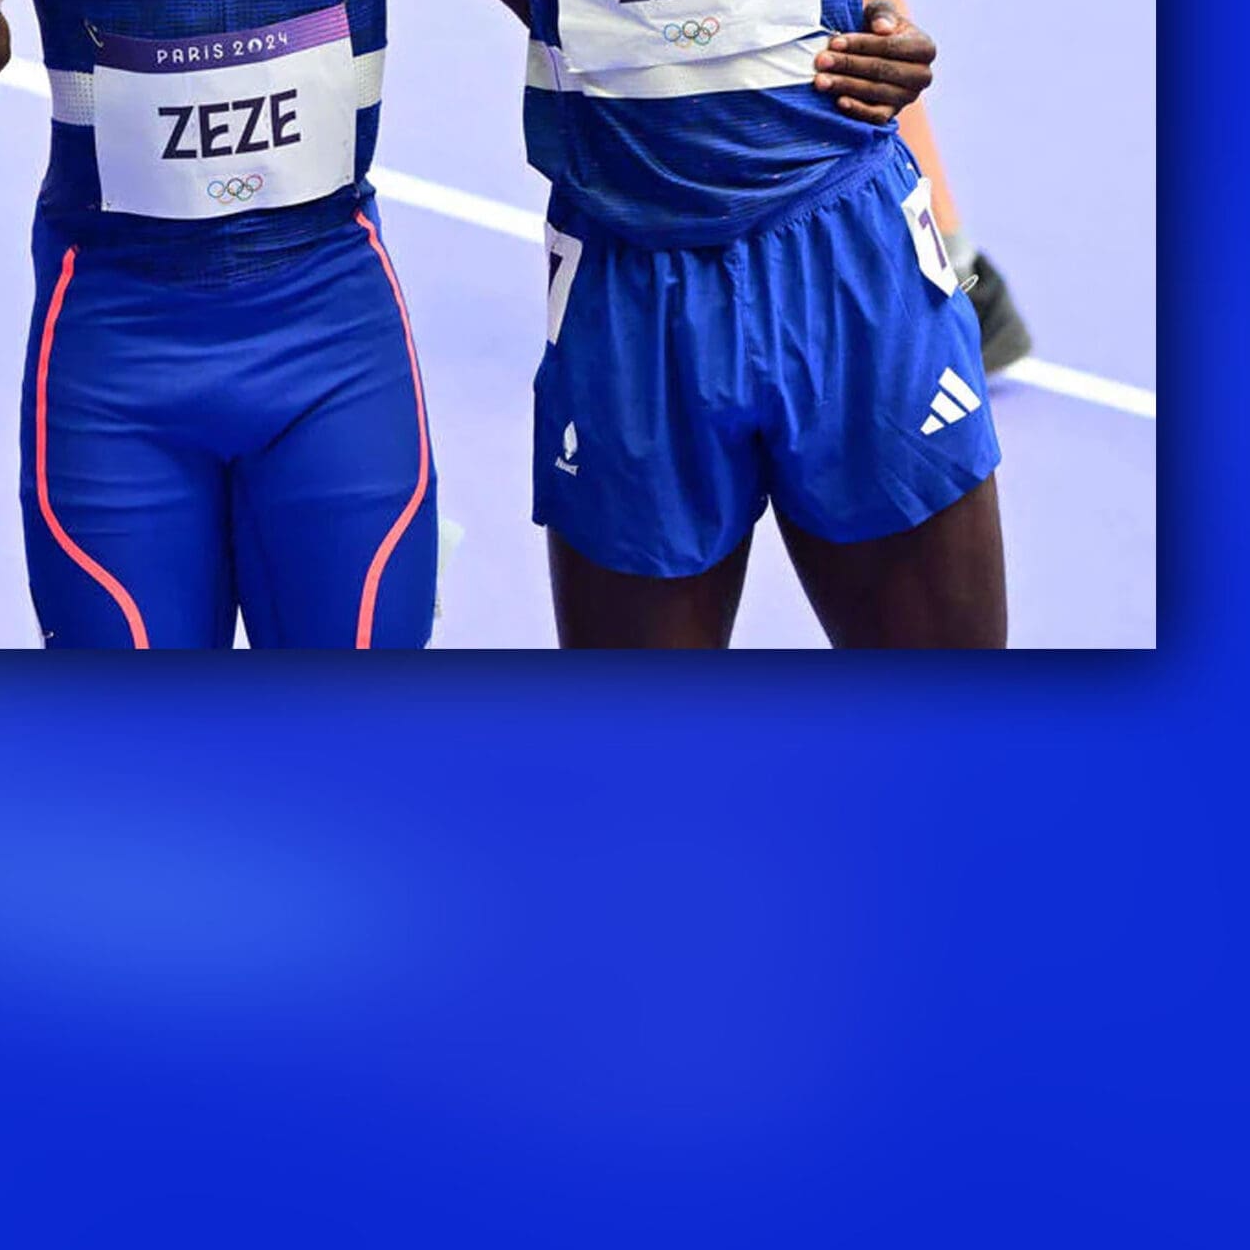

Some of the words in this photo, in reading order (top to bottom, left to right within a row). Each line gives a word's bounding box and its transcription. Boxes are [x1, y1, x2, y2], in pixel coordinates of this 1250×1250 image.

[156, 43, 224, 64] PARIS
[232, 31, 288, 56] 2024
[157, 88, 302, 160] ZEZE
